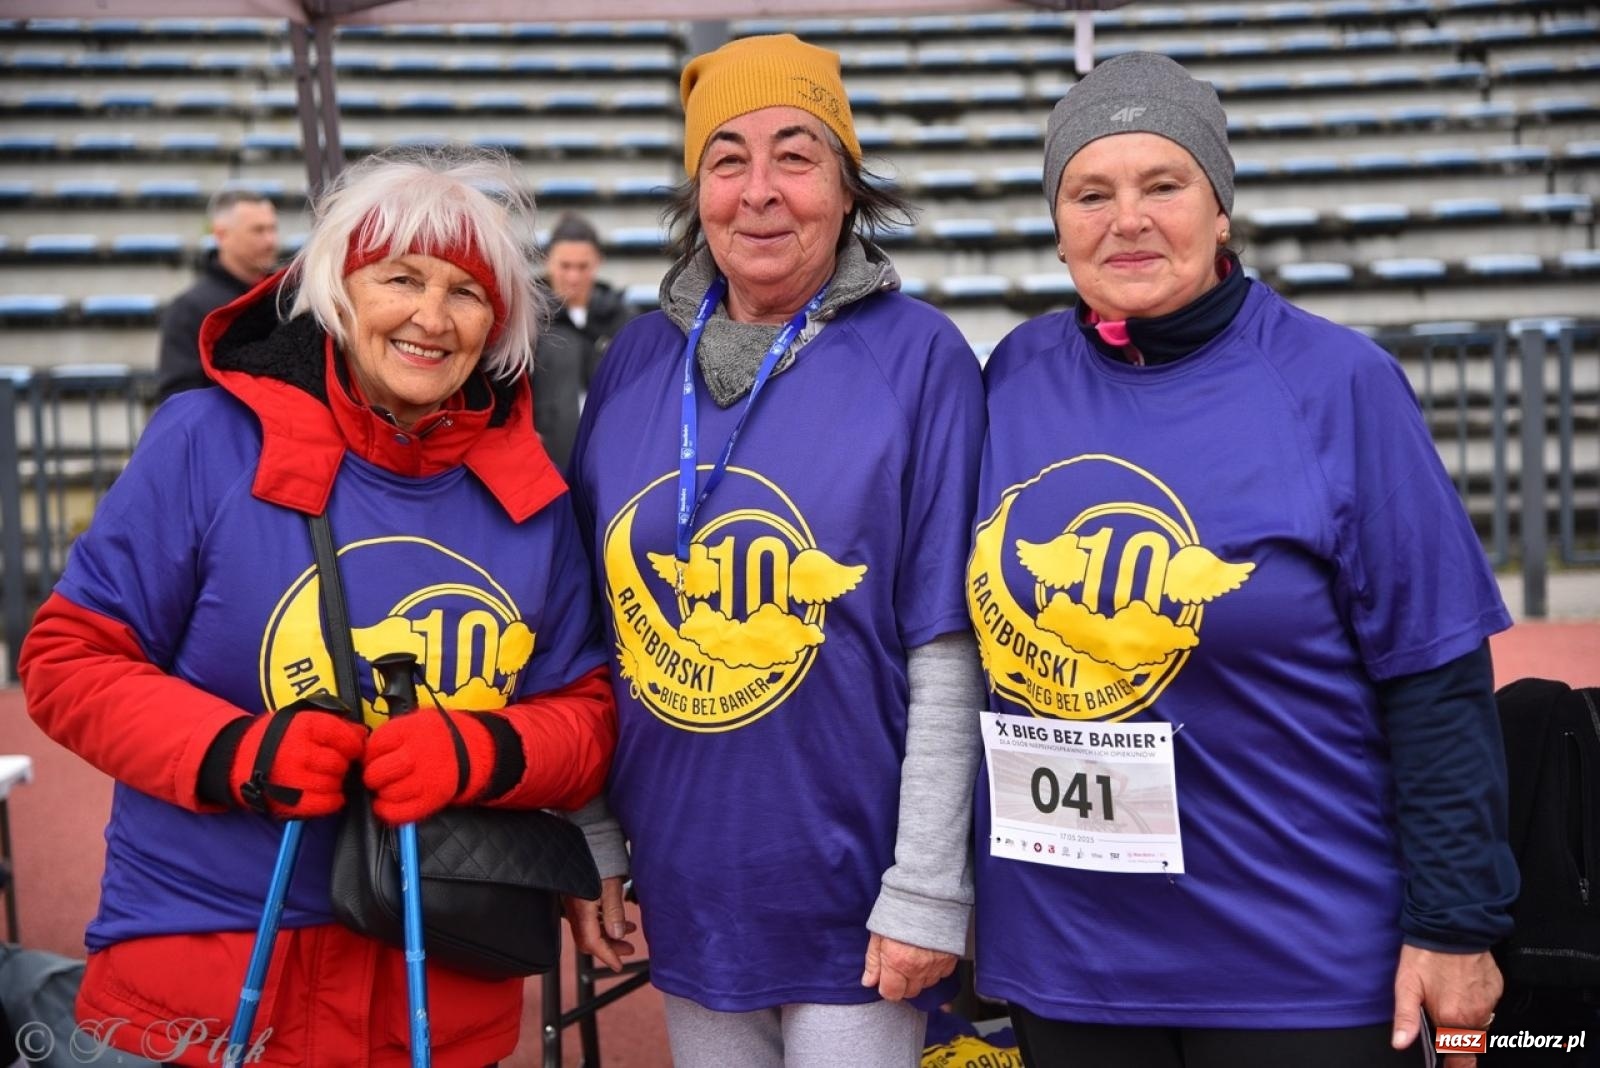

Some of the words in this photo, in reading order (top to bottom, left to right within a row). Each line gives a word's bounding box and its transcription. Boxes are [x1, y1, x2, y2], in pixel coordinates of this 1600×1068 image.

[1110, 107, 1147, 122] 4F
[707, 536, 789, 620] 10
[1077, 527, 1170, 616] 10
[411, 609, 499, 694] 10
[618, 587, 714, 693] RACIBORSKI
[973, 572, 1078, 688] RACIBORSKI
[283, 657, 330, 698] RA
[659, 686, 687, 712] BIEG
[692, 698, 717, 715] BEZ
[720, 677, 770, 713] BARIER
[1025, 678, 1052, 706] BIEG
[1056, 693, 1081, 712] BEZ
[1012, 724, 1048, 741] BIEG
[1054, 729, 1084, 745] BEZ
[1089, 733, 1156, 748] BARIER
[1030, 767, 1114, 820] 041
